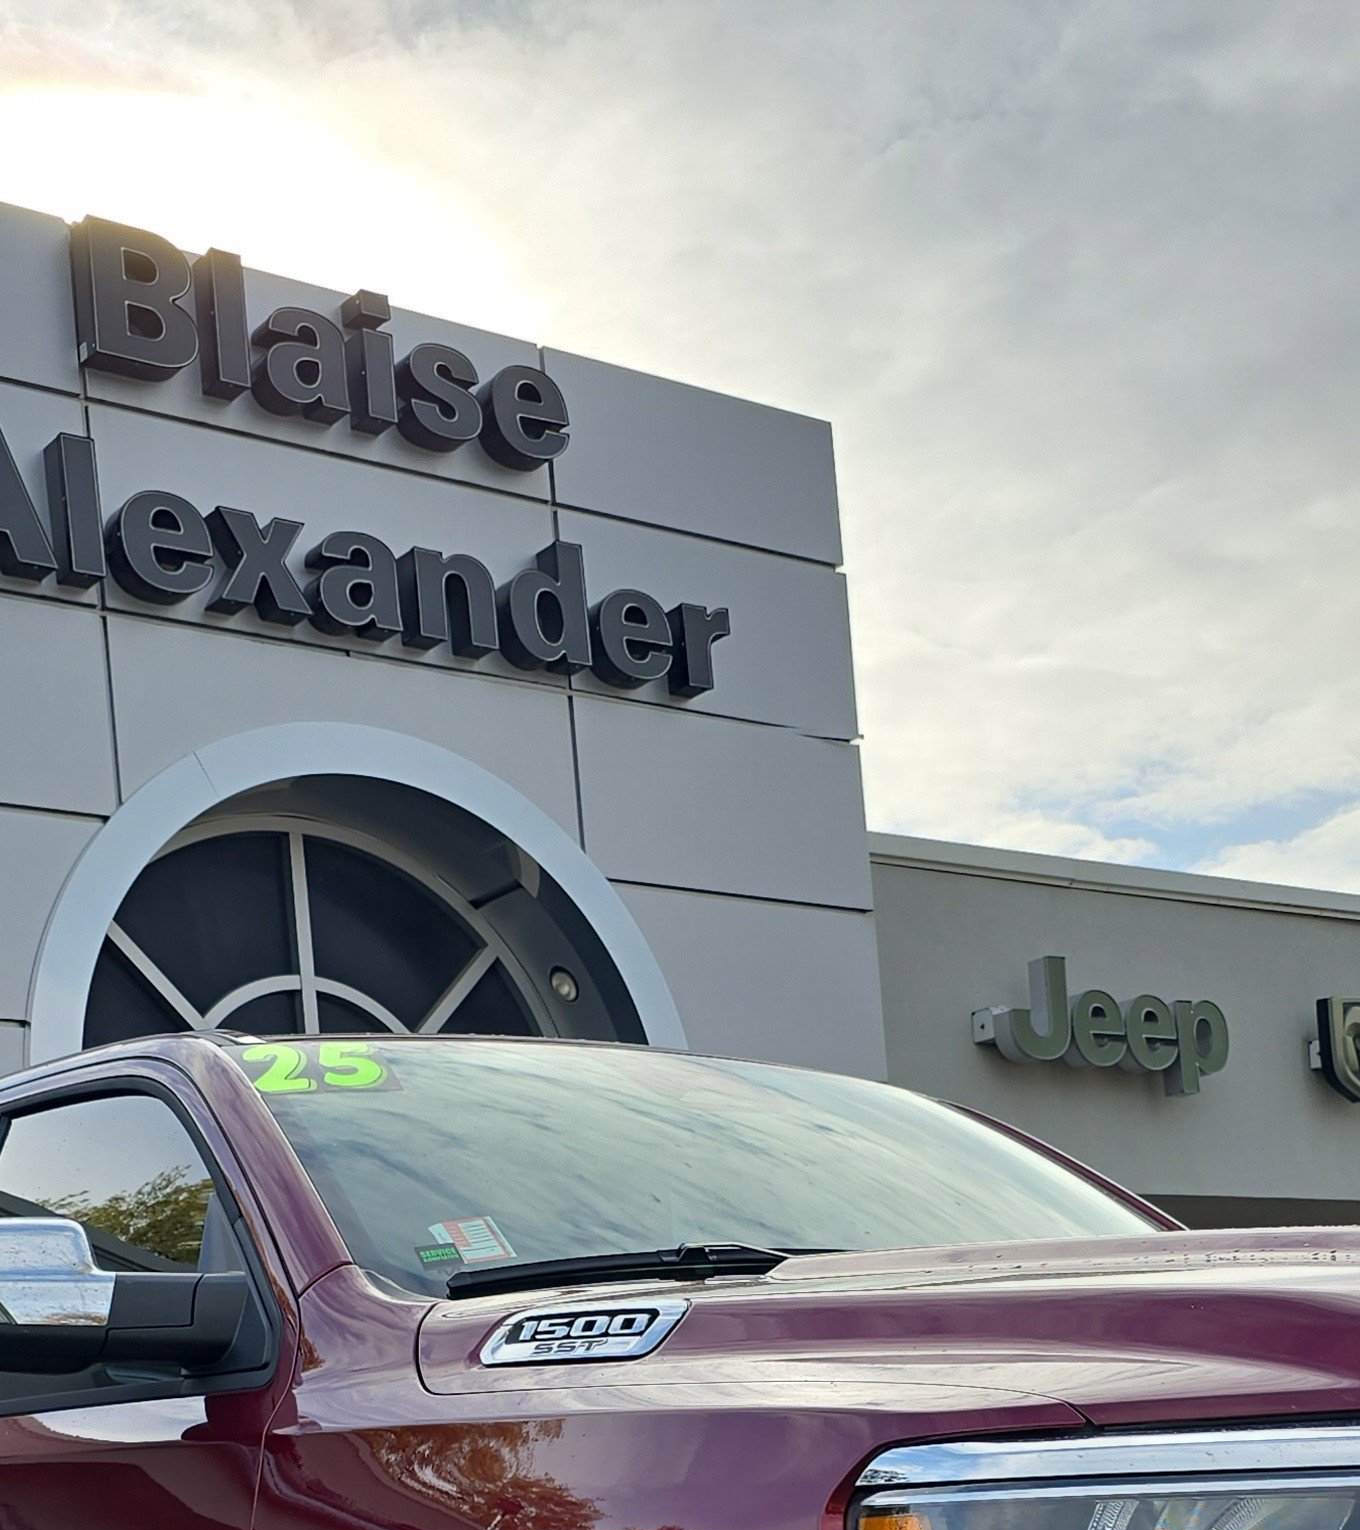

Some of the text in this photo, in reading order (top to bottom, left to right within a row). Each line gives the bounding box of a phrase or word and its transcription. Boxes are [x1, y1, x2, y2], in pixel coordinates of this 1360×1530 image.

[70, 214, 572, 472] Blaise
[992, 956, 1229, 1097] Jeep
[242, 1042, 388, 1094] 25
[518, 1313, 652, 1341] 1500
[533, 1338, 609, 1355] SST
